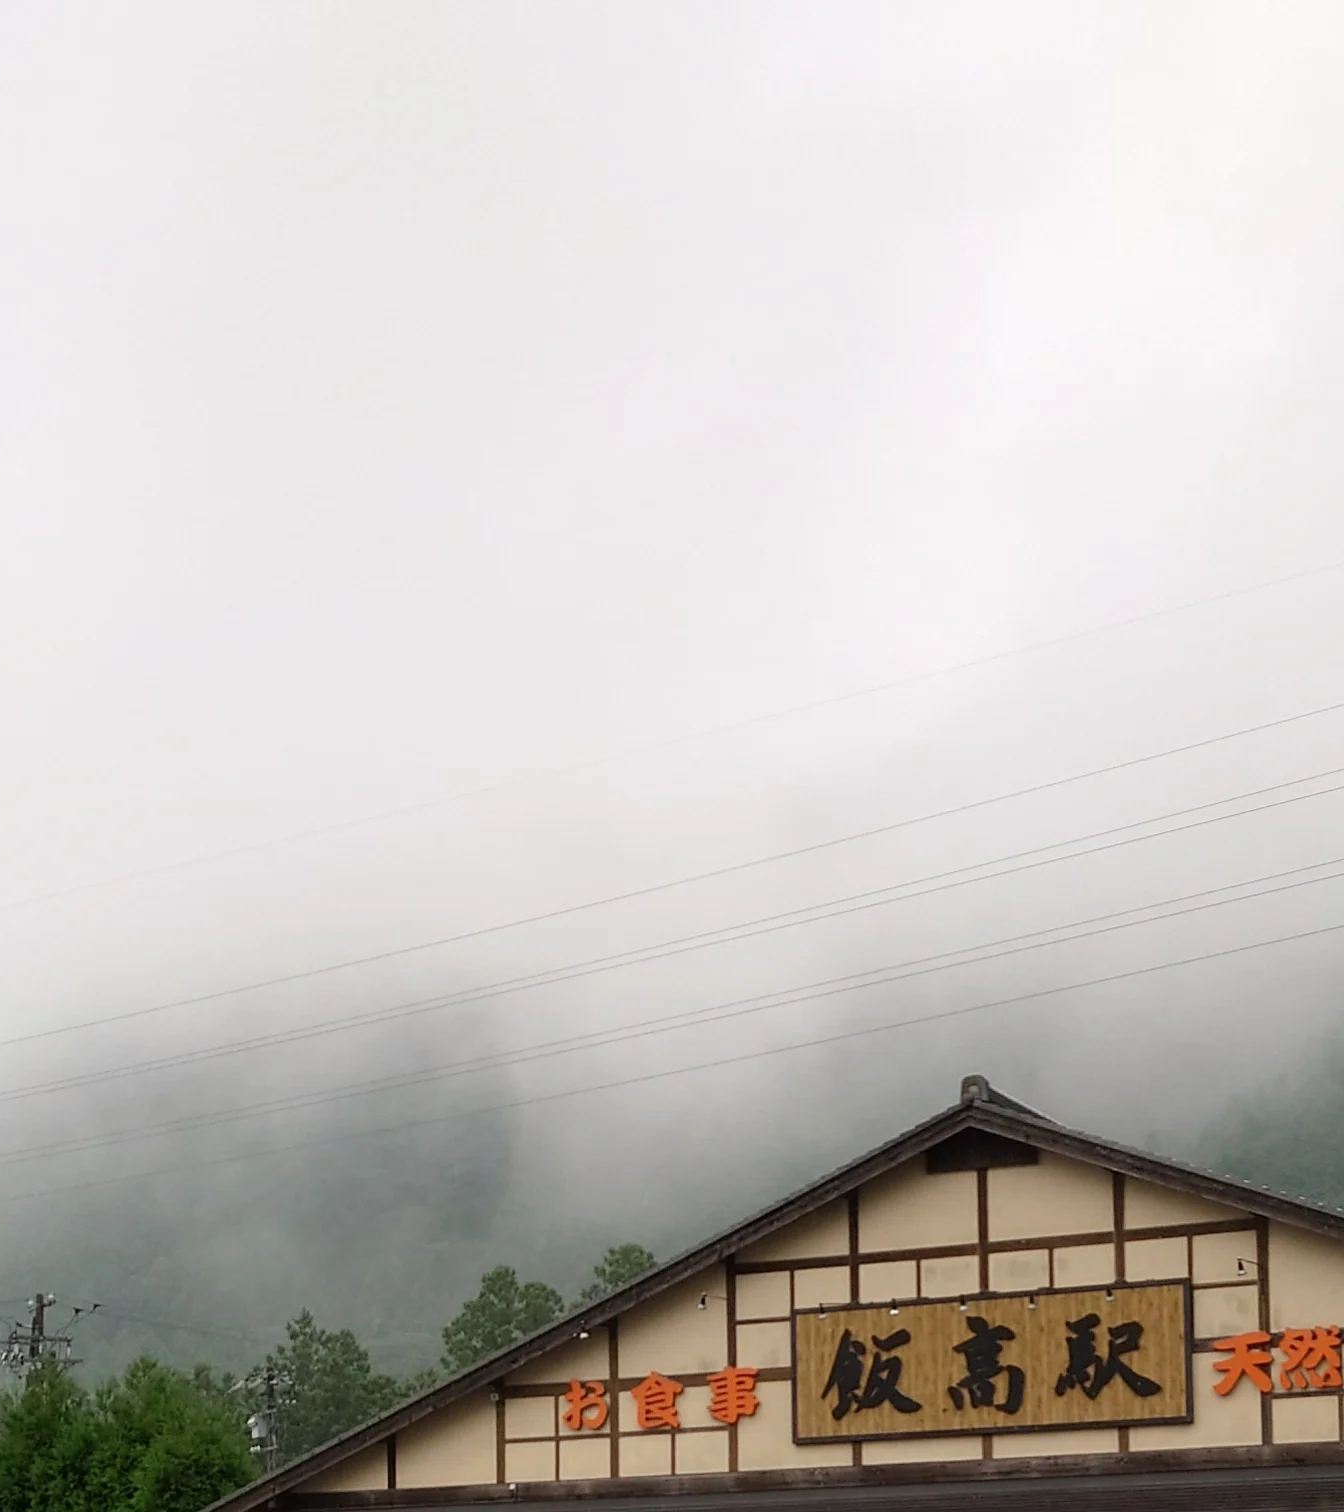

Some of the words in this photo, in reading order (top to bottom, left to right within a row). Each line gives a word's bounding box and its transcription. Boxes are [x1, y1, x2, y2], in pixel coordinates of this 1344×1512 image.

[561, 1365, 761, 1432] お食事
[819, 1312, 1163, 1422] 飯高駅
